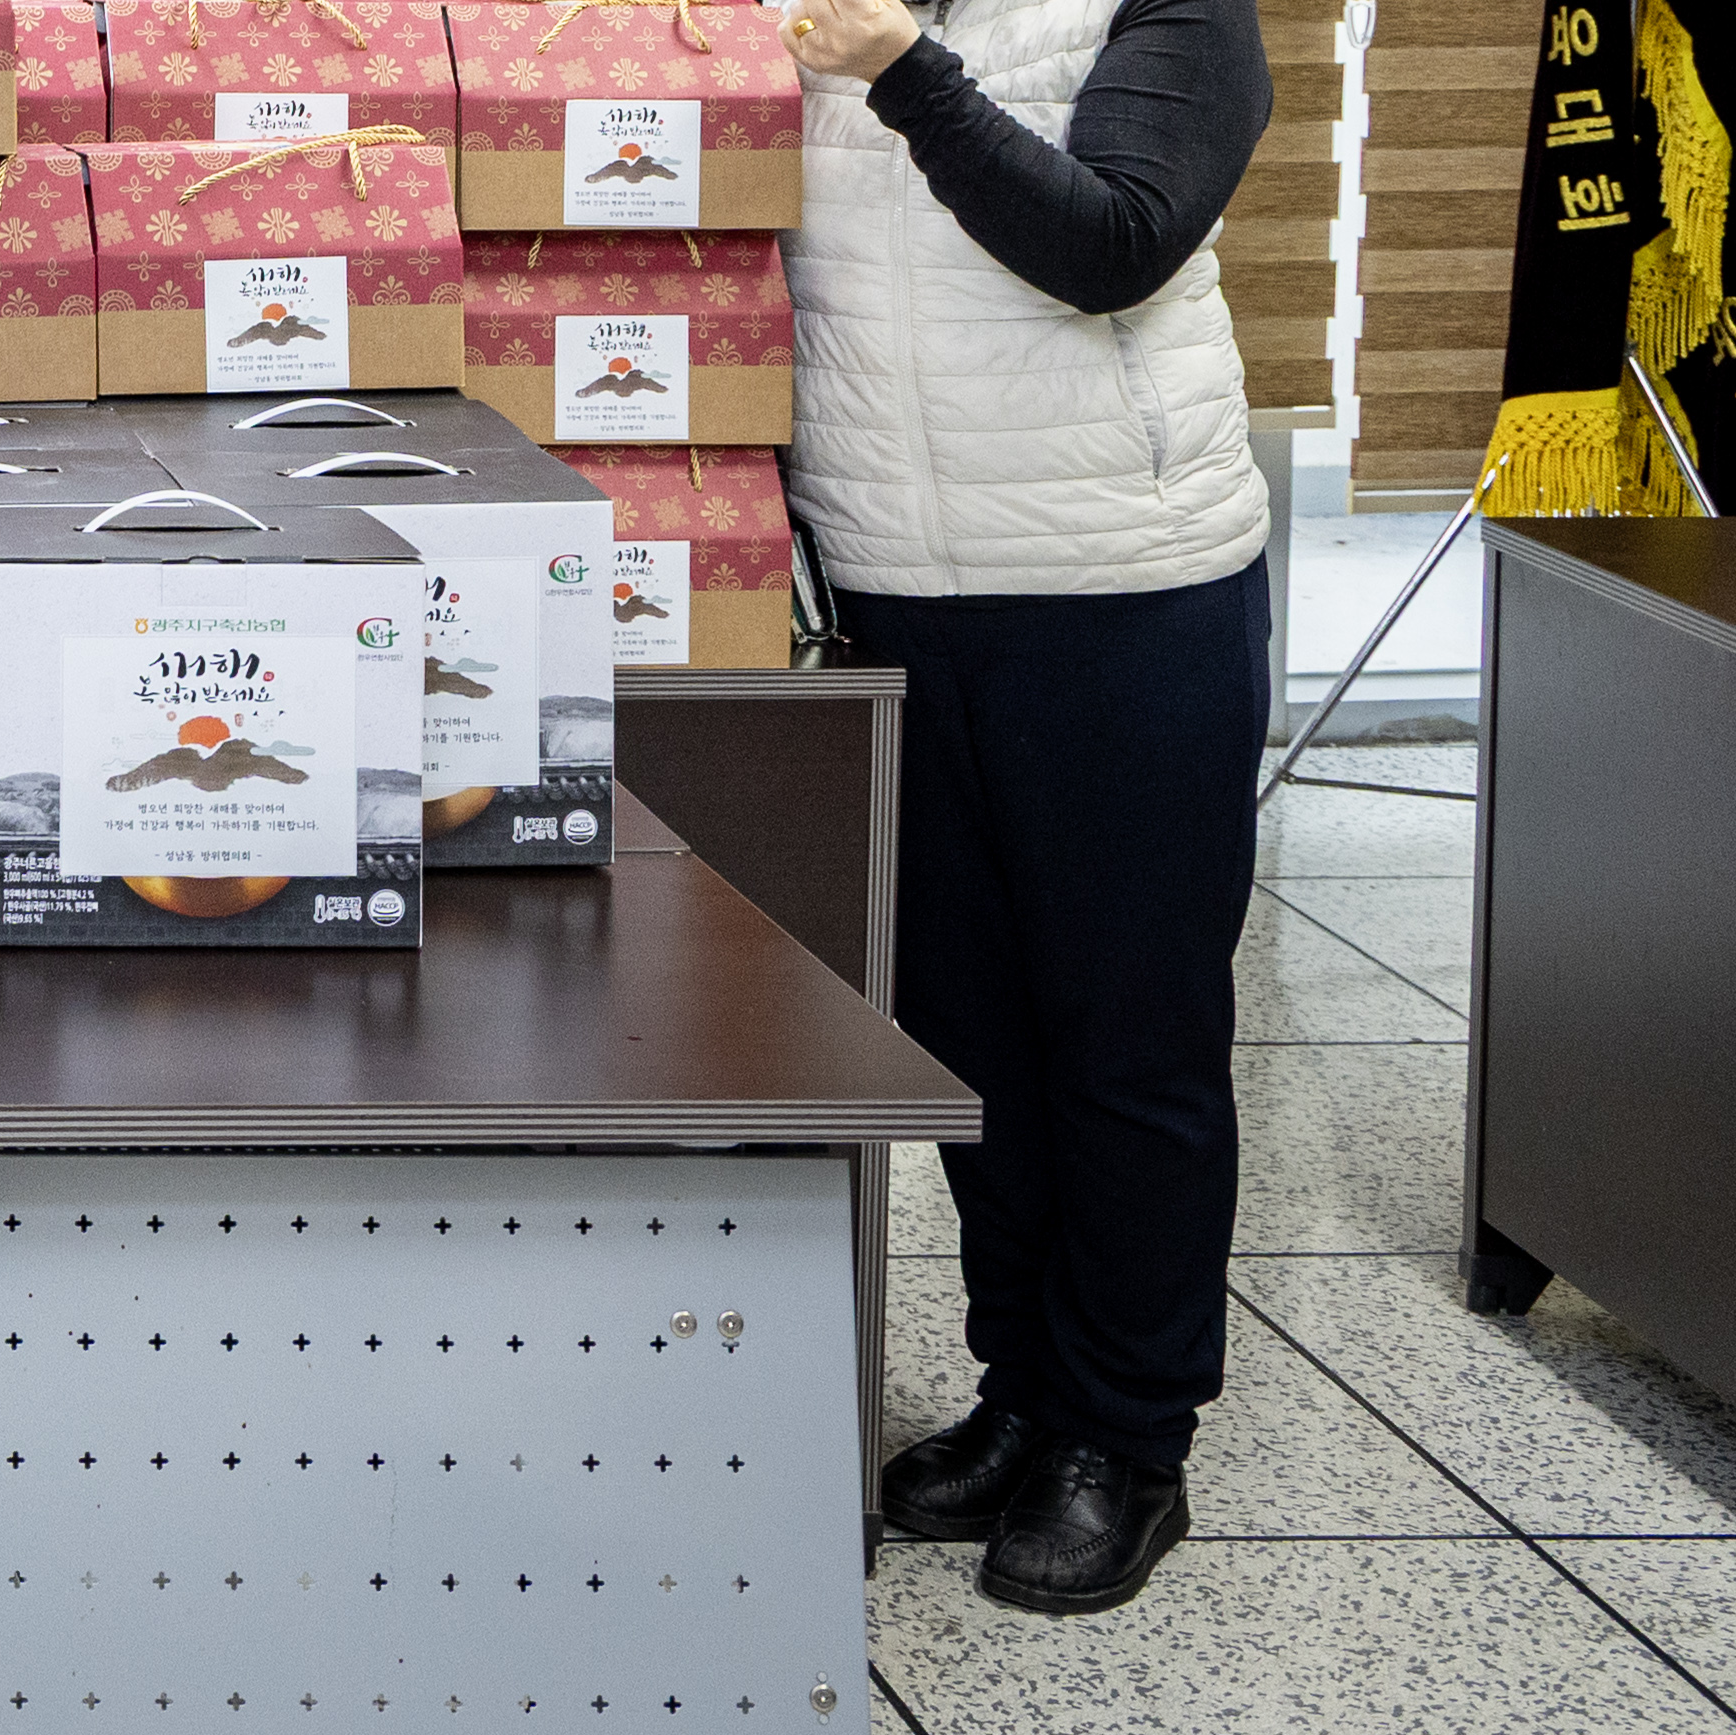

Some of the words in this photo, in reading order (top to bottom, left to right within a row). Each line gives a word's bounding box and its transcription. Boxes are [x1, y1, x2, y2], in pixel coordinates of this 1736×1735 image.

[152, 618, 286, 632] 광주지구축산농협
[150, 649, 260, 679] 새해
[138, 804, 168, 814] 병오년
[174, 804, 204, 814] 희망찬
[209, 804, 239, 814] 새해를
[245, 804, 285, 815] 맞이하여
[104, 820, 134, 831] 가정에
[139, 820, 169, 831] 건강과
[175, 820, 205, 831] 행복이
[211, 820, 260, 831] 가득하기를
[165, 850, 195, 861] 성남동
[201, 850, 251, 861] 방위협의회
